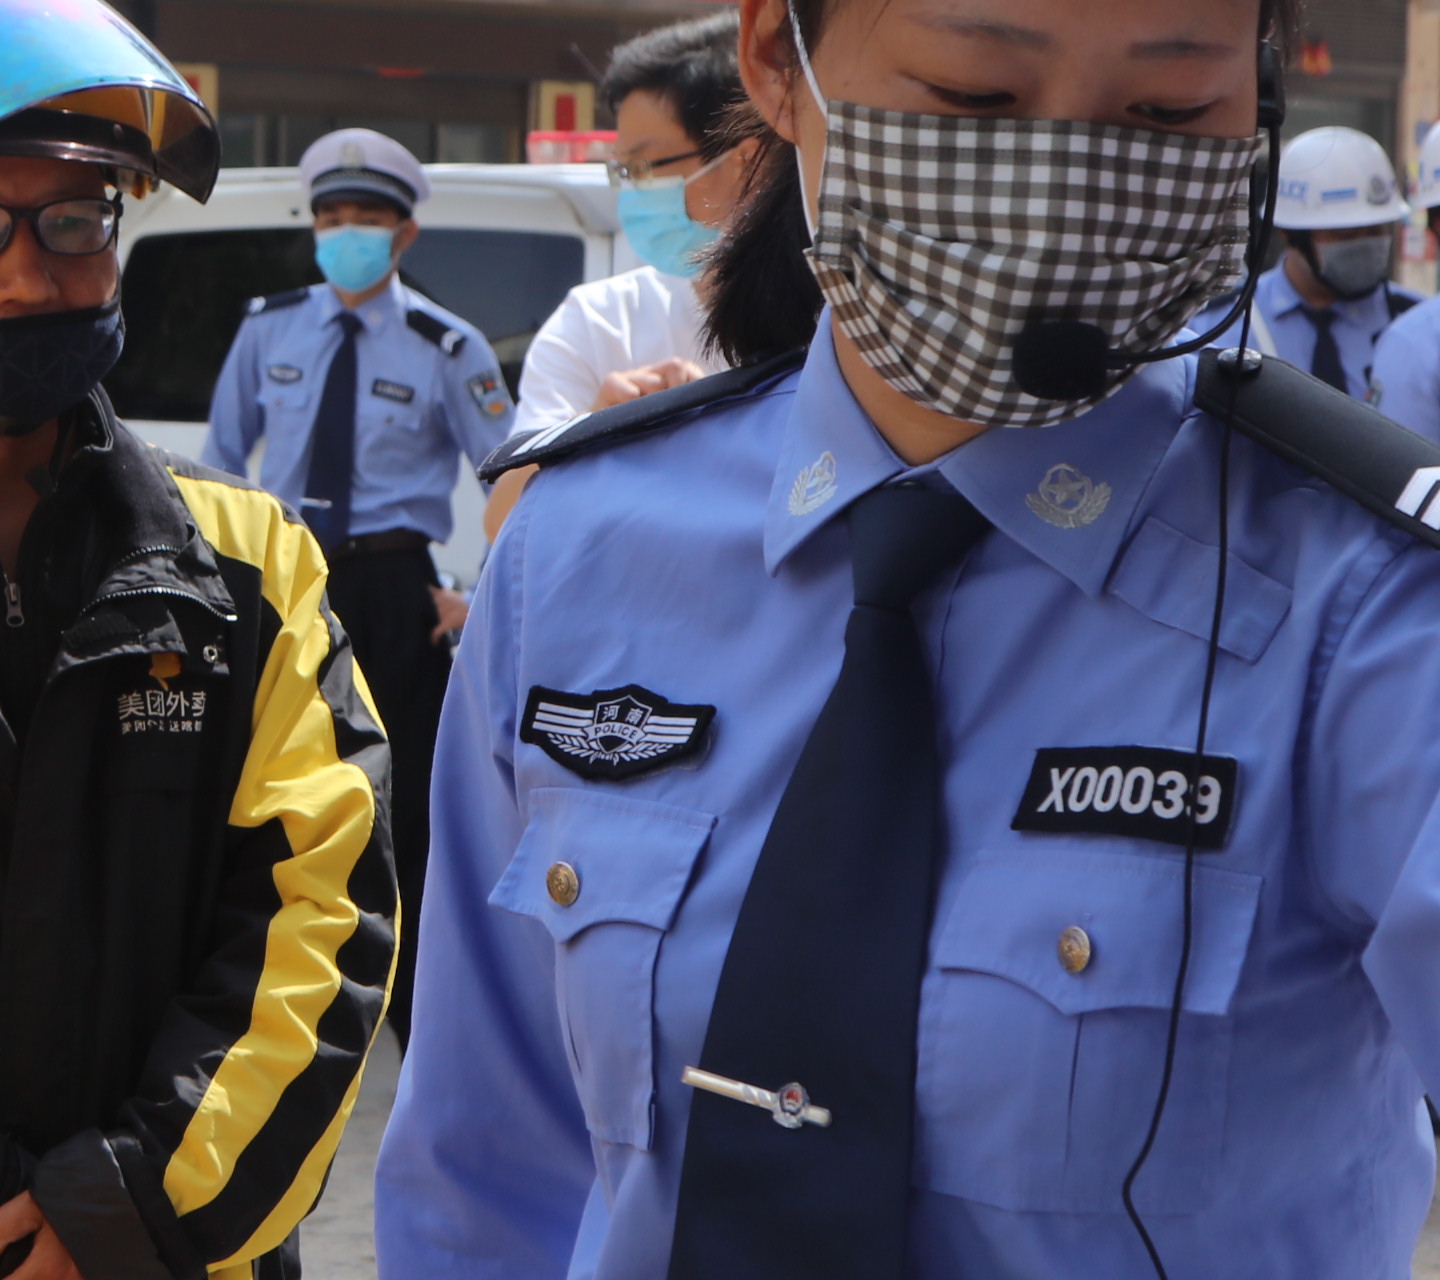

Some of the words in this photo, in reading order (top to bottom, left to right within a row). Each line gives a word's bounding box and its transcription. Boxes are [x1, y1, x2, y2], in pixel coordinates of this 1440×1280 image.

[602, 705, 644, 725] 河南
[594, 723, 638, 740] POLICE
[1036, 765, 1222, 824] X00039
